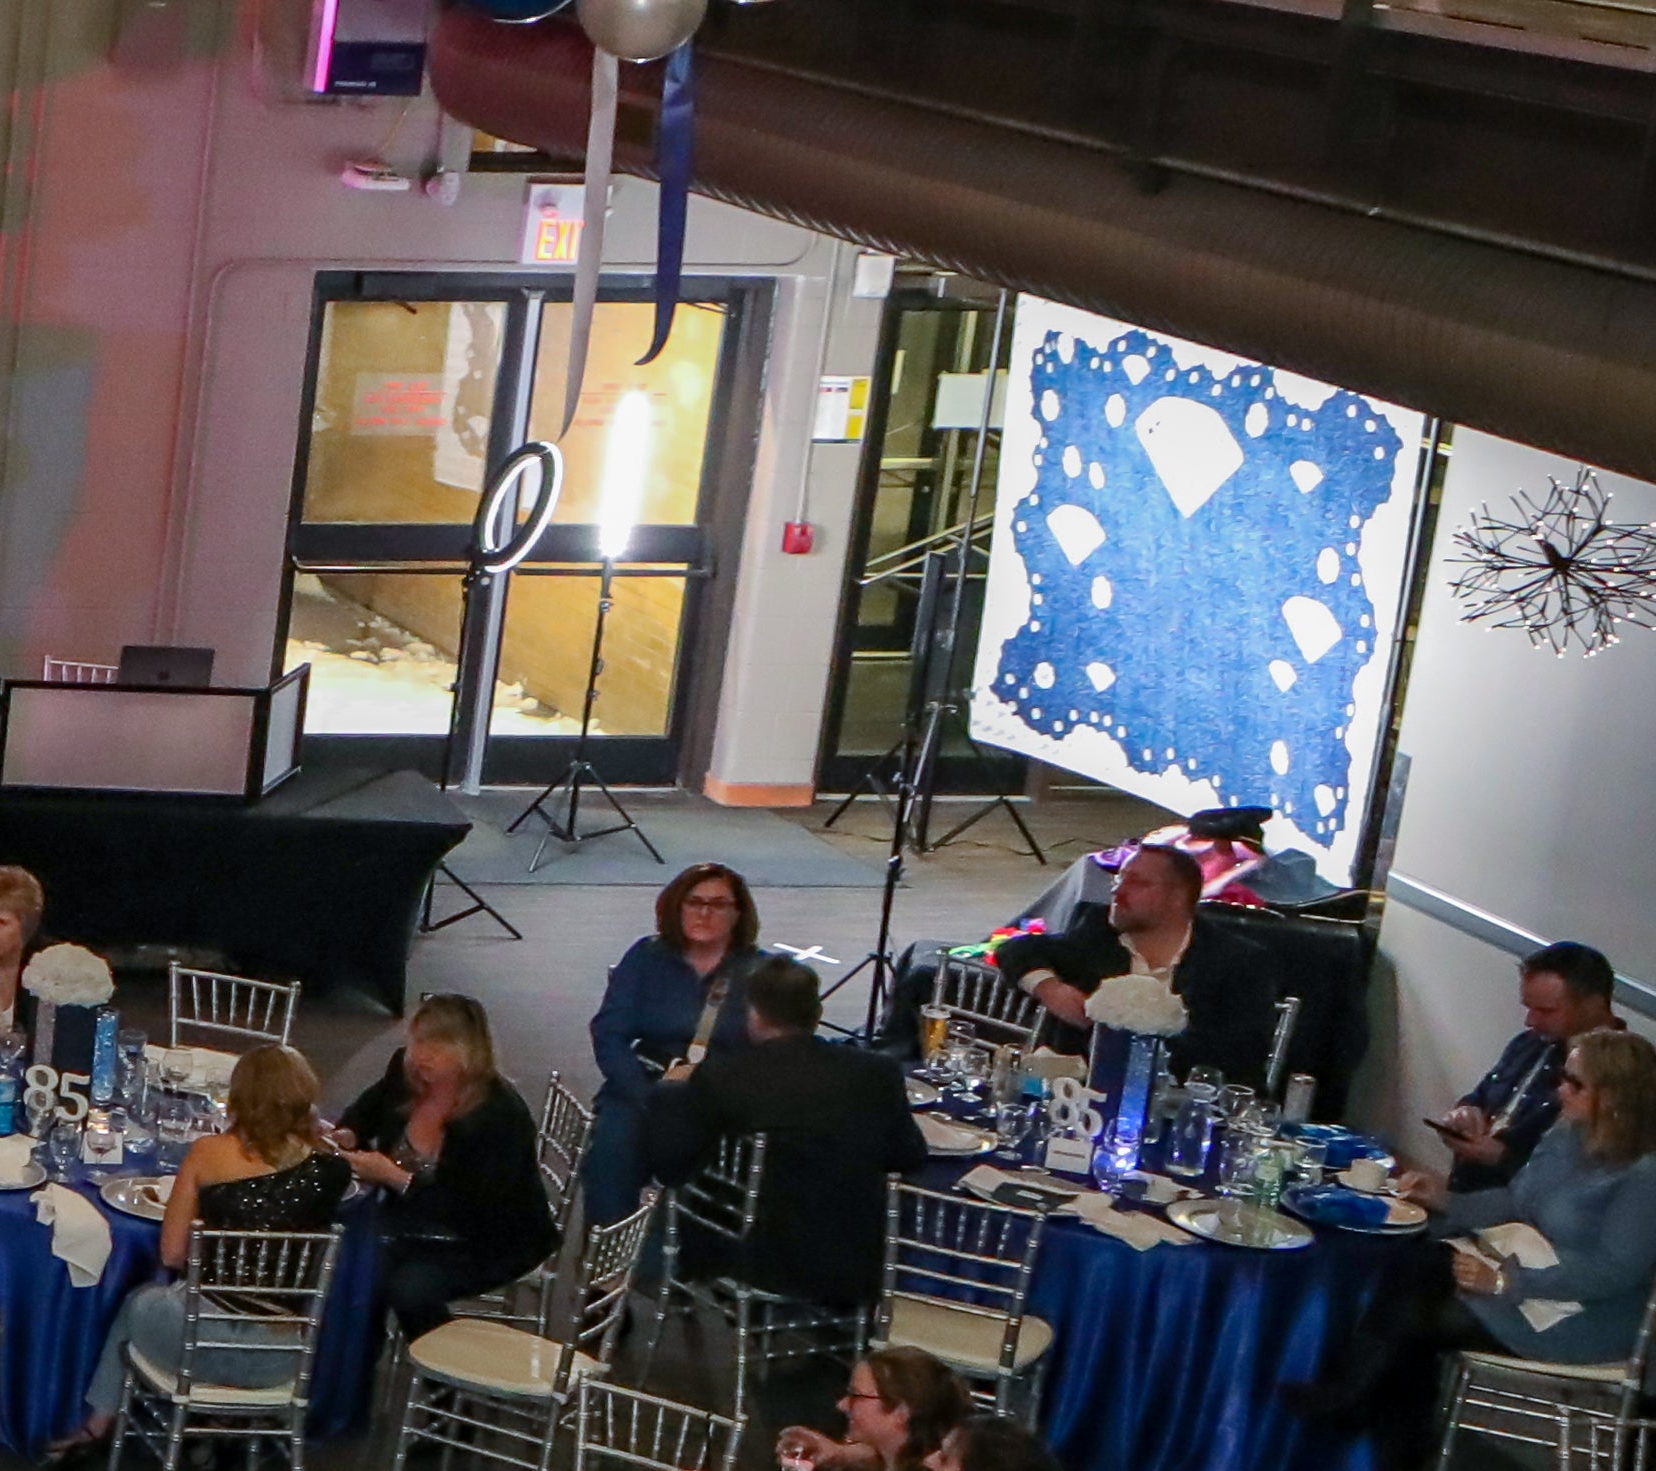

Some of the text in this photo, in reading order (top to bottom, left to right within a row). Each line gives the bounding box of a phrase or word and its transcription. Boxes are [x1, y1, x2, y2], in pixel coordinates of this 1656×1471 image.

[535, 218, 584, 260] EXI
[23, 1064, 91, 1121] 85
[1049, 1077, 1108, 1137] 85
